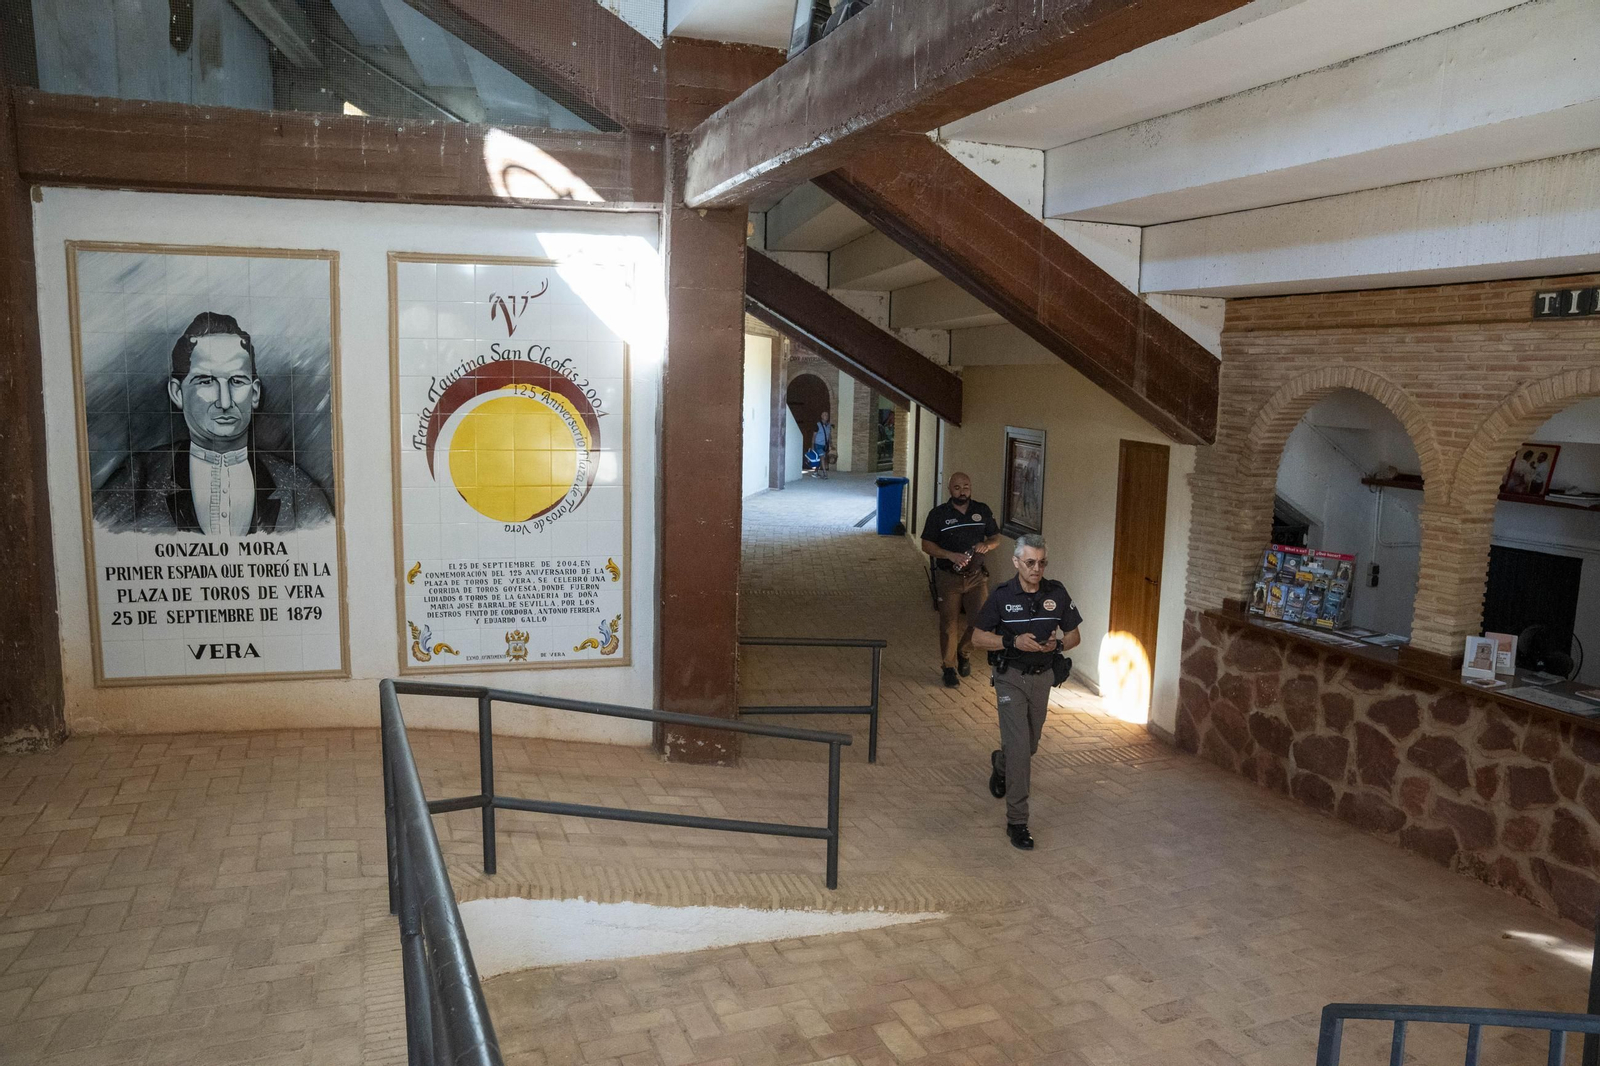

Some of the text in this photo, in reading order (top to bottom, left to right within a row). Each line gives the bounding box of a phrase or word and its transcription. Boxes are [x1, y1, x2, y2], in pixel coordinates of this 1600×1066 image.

[1539, 289, 1600, 314] TI
[412, 343, 610, 450] Feria Taurina San Cleofás 2004
[514, 384, 536, 399] 125
[542, 391, 587, 448] Aniversario
[570, 483, 582, 498] de
[546, 498, 575, 524] Toros
[504, 524, 531, 535] Vera
[534, 519, 545, 534] de
[155, 541, 288, 557] GONZALO MORA
[105, 560, 331, 581] PRIMER ESPADA QUE TOREÓ EN LA
[425, 569, 487, 579] CONMEMORACIÓN
[459, 562, 468, 570] 25
[554, 574, 588, 583] CELEBRÓ
[117, 585, 325, 603] PLAZA DE TOROS DE VERA
[111, 606, 322, 625] 25 DE SEPTIEMBRE DE 1879
[187, 643, 261, 660] VERA
